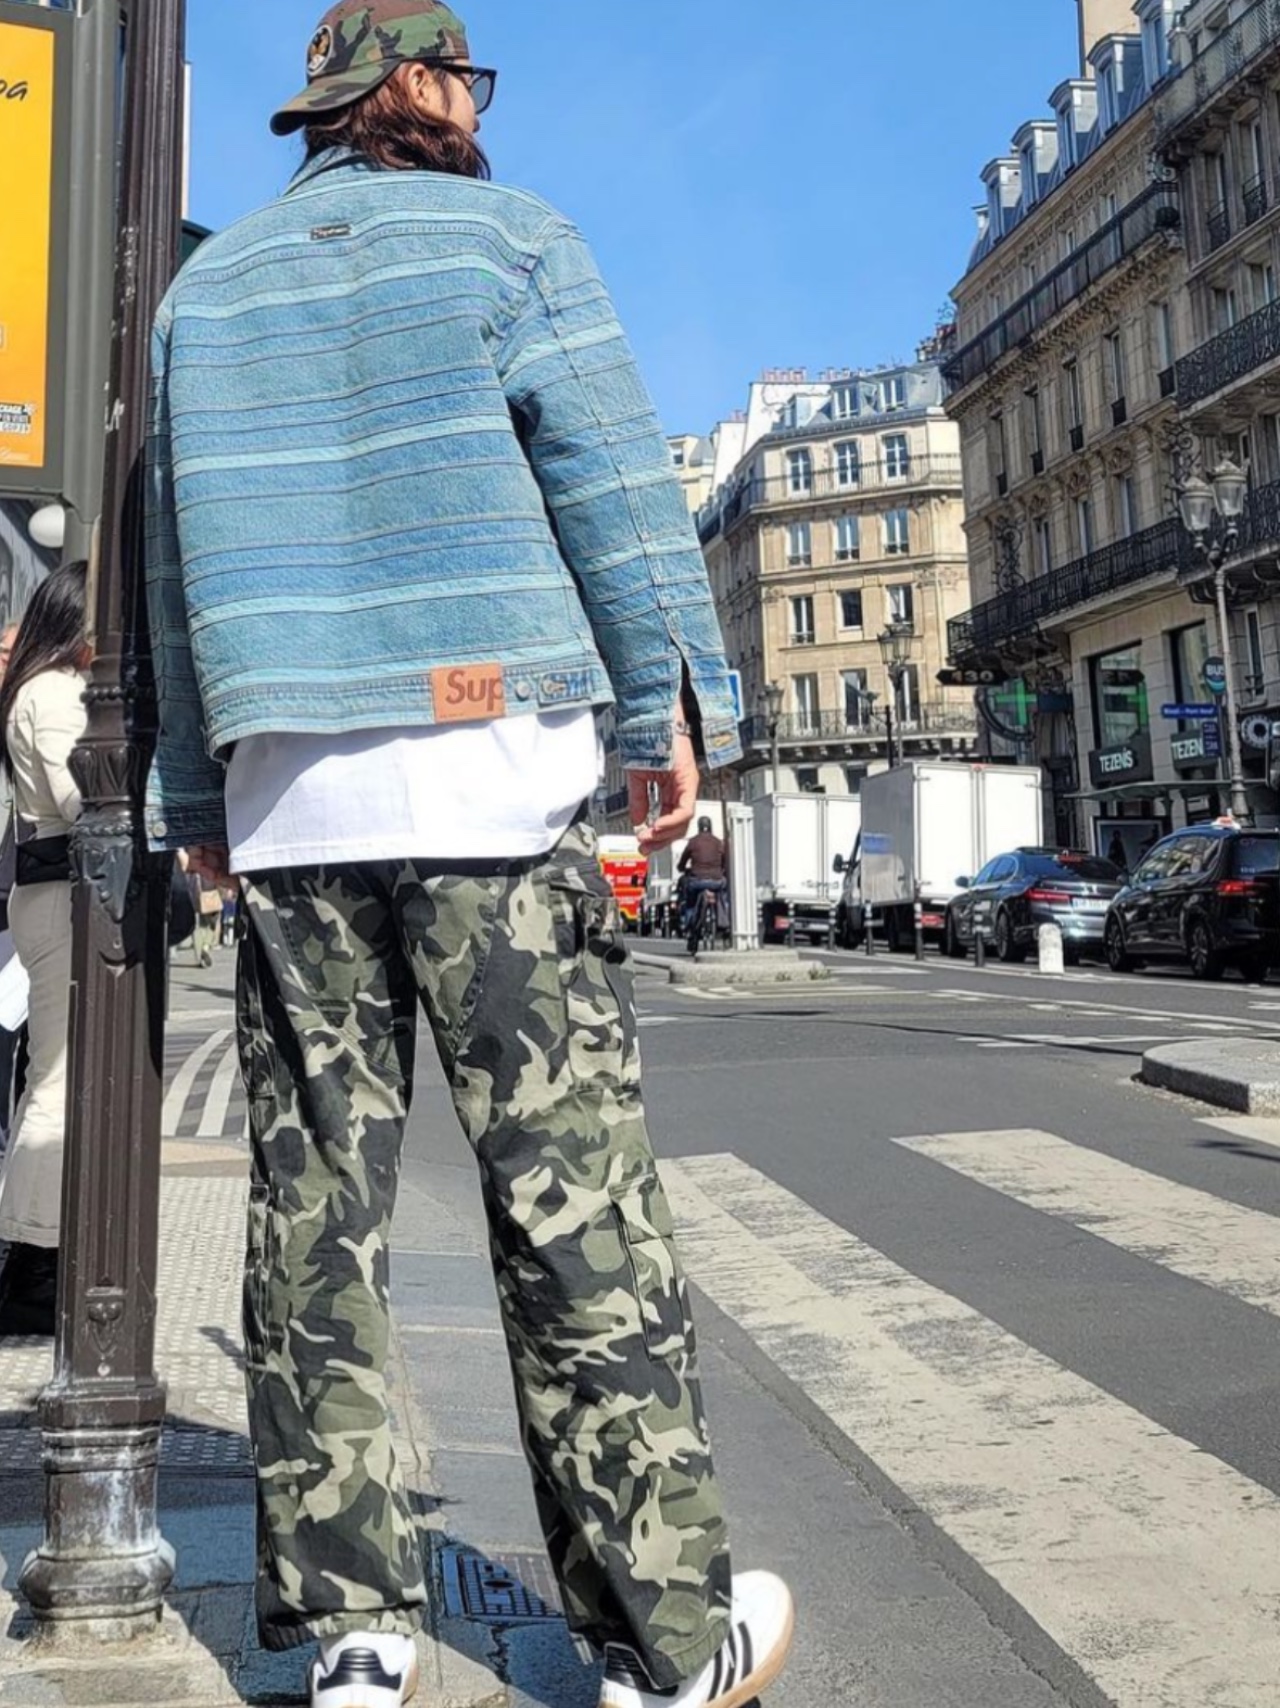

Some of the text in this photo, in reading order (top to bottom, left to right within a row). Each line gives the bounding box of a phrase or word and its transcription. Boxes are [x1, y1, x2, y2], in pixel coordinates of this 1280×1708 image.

[445, 669, 504, 712] Sup
[1099, 747, 1133, 773] TEZENIS
[1171, 739, 1204, 759] TEZEN
